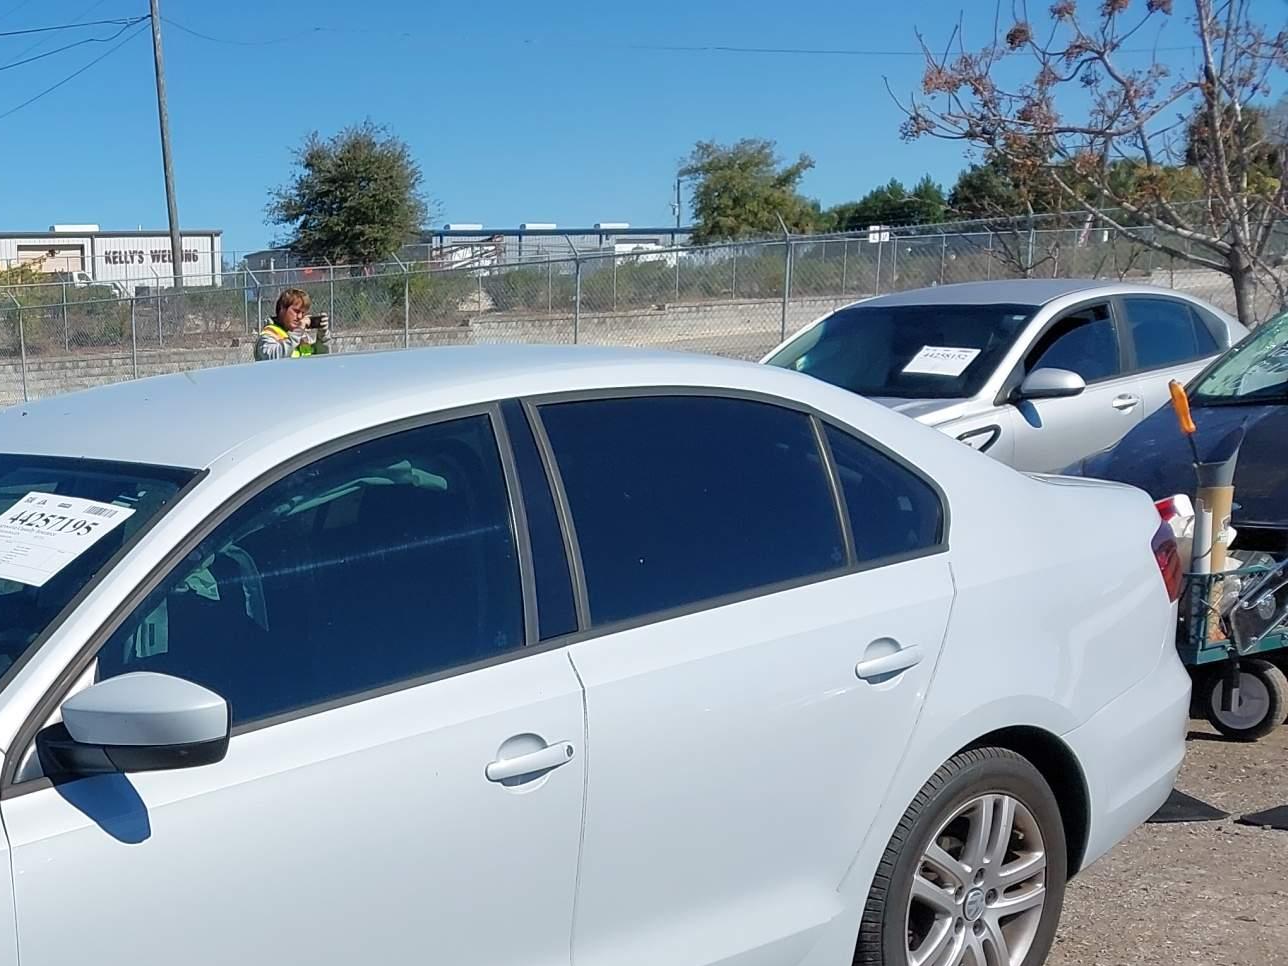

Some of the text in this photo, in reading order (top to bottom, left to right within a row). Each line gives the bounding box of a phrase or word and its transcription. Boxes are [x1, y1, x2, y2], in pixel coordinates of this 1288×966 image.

[105, 249, 199, 264] KELLY'S WELING
[10, 511, 99, 536] 44257195
